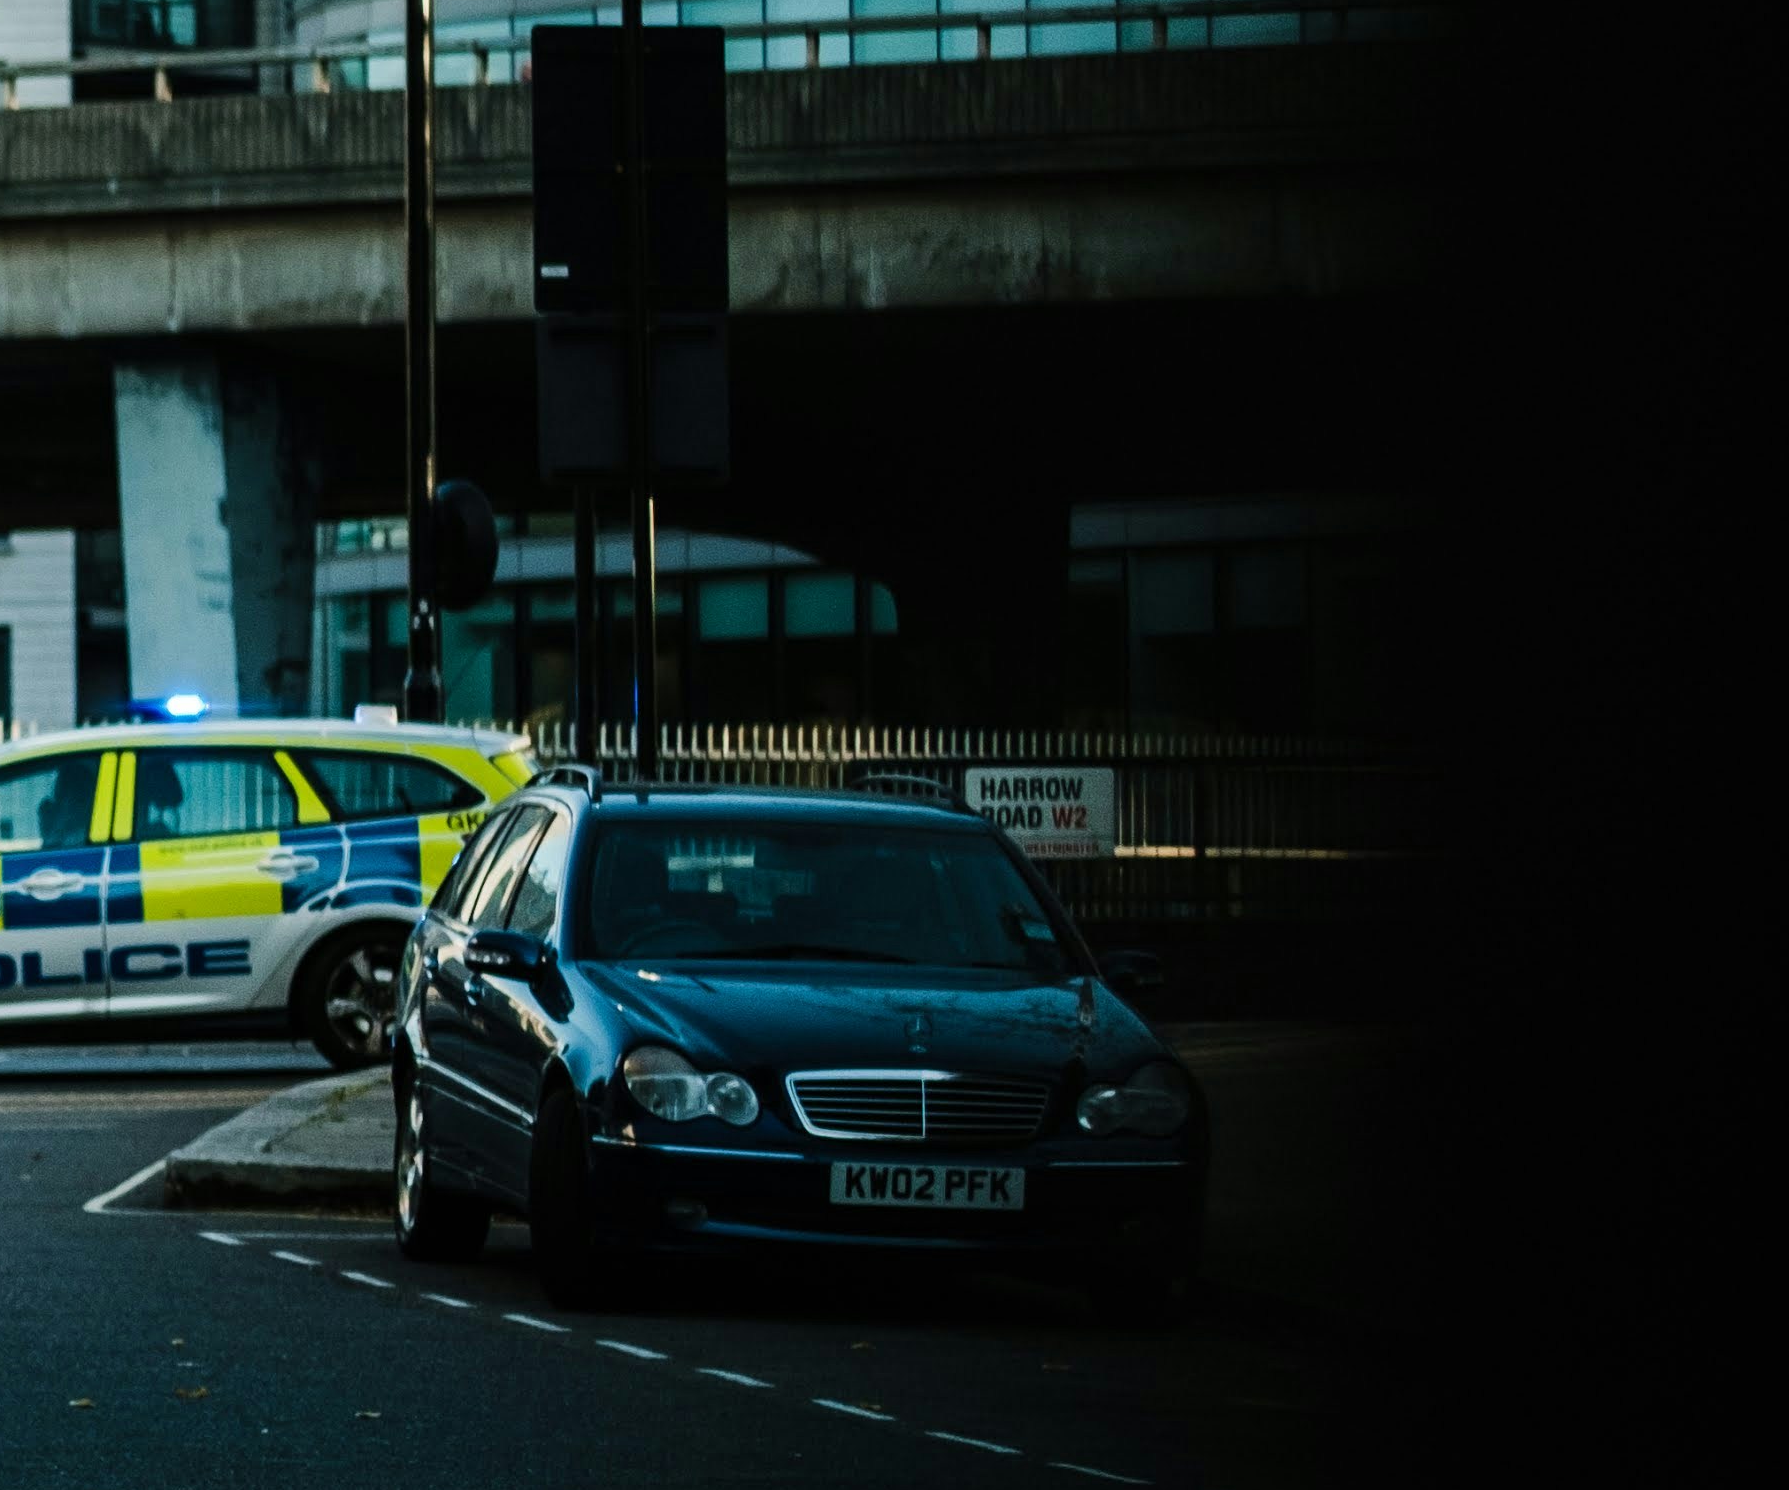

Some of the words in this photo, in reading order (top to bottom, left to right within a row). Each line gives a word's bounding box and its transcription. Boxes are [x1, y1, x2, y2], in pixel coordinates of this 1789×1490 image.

[980, 776, 1083, 801] HARROW
[1051, 805, 1087, 830] W2
[845, 1165, 935, 1200] KW02
[945, 1170, 1012, 1202] PFK
